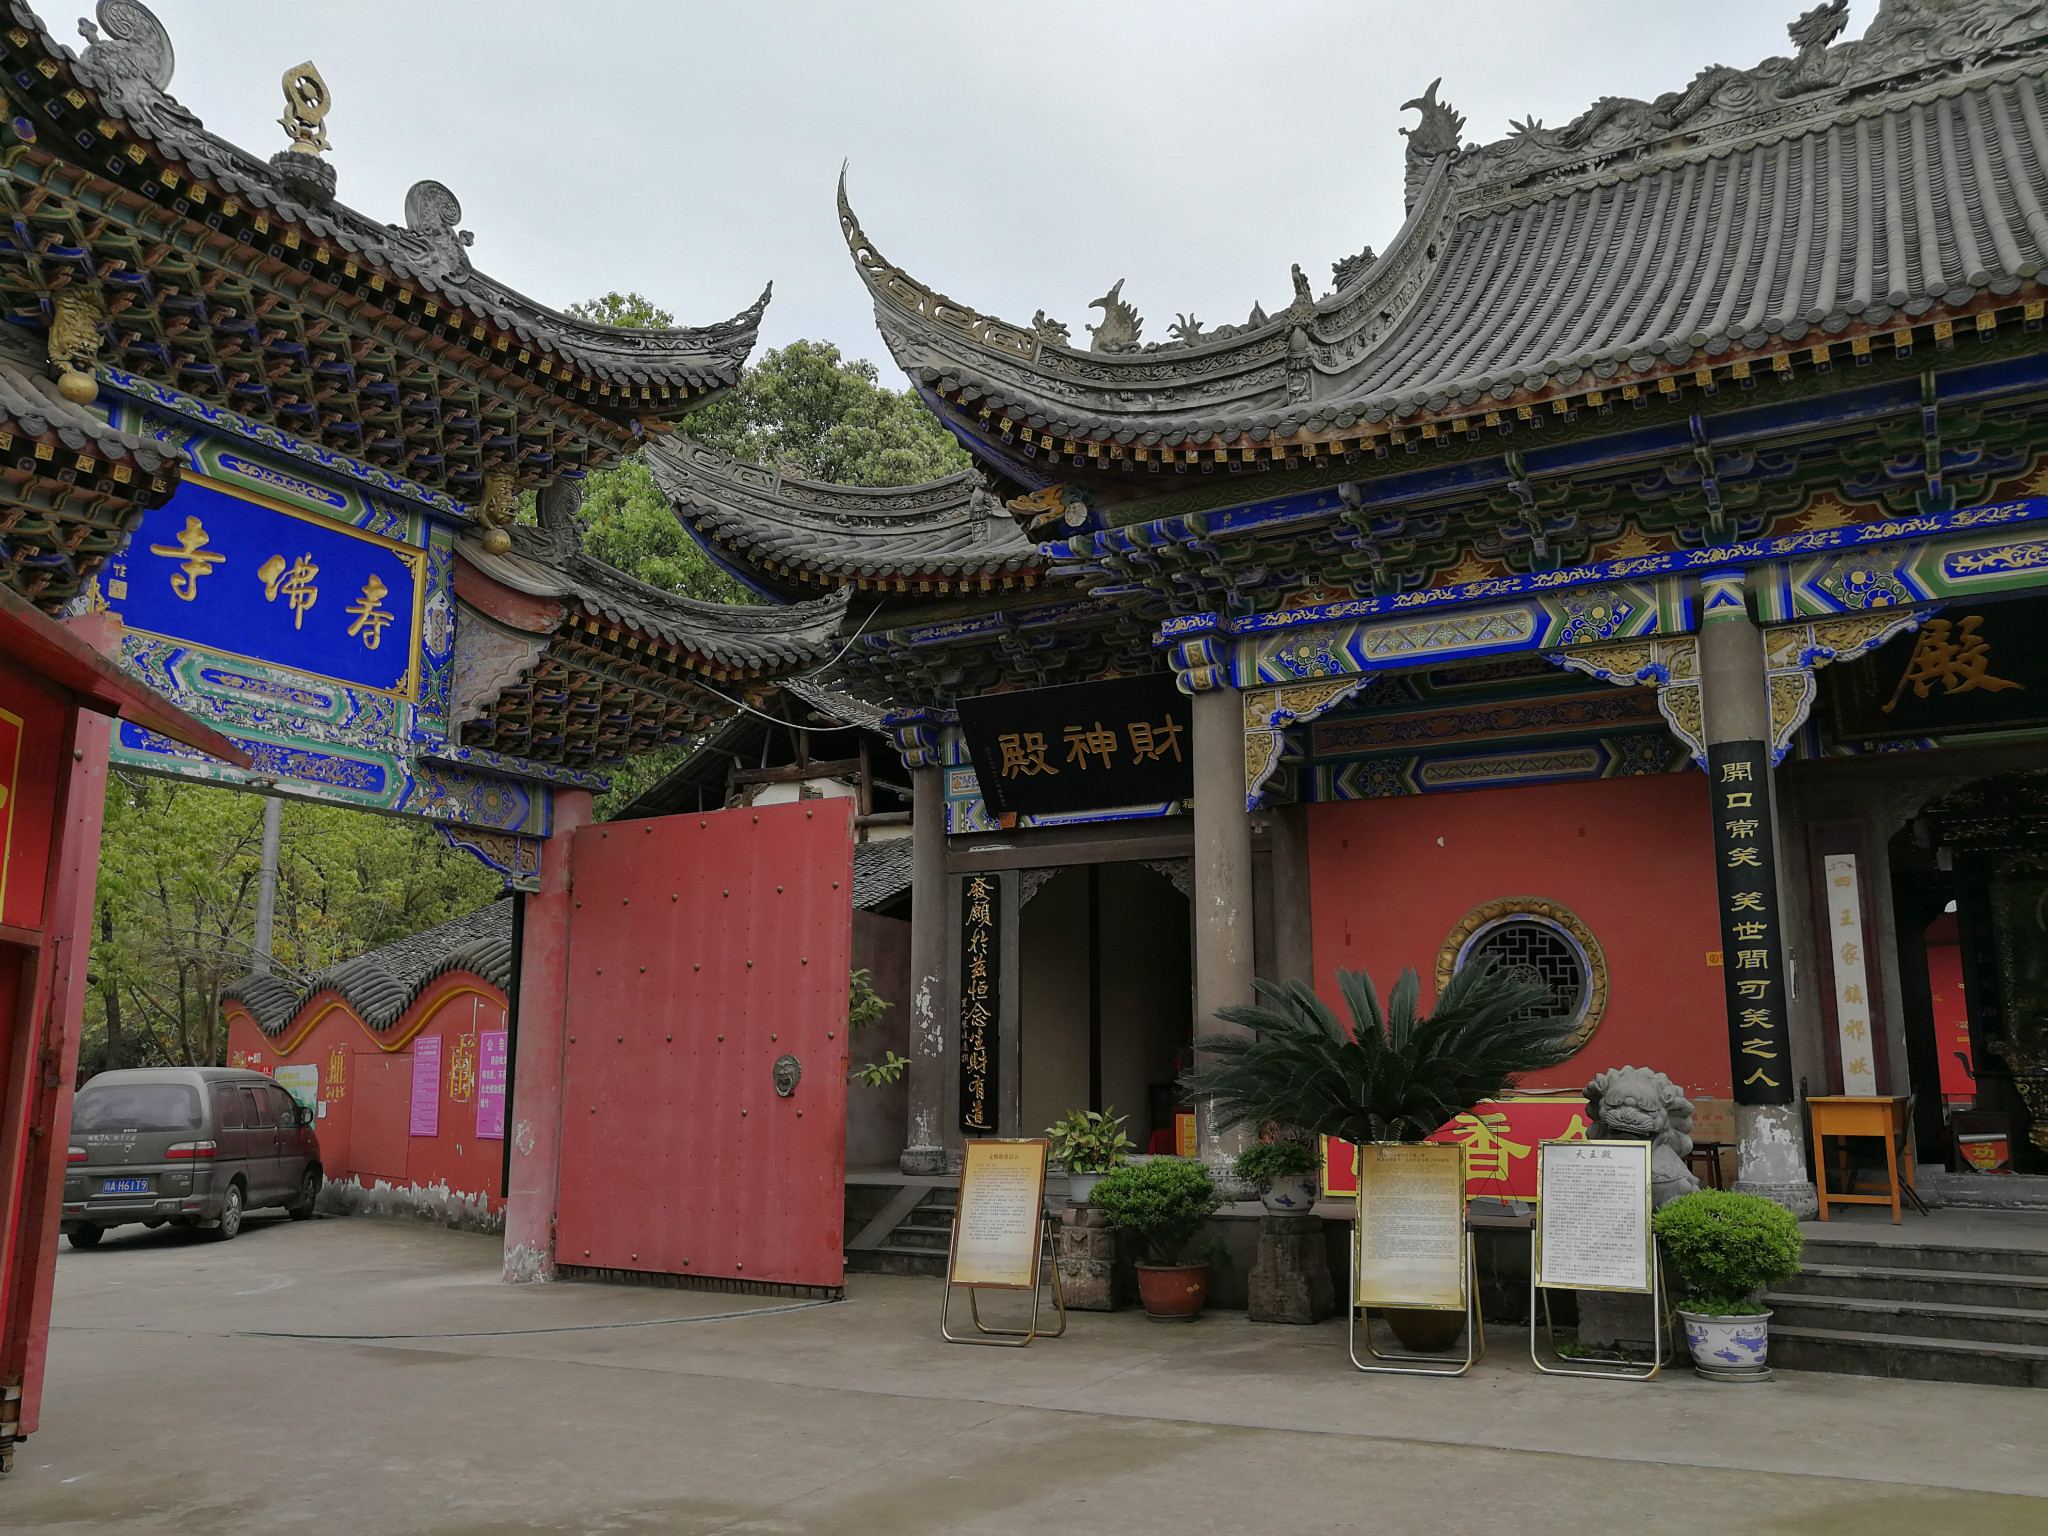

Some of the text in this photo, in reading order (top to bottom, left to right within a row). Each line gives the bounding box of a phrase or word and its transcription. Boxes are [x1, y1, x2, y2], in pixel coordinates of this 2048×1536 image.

[1881, 615, 2027, 713] 殿
[998, 713, 1184, 780] 財神殿
[1575, 1149, 1613, 1159] 天王殿
